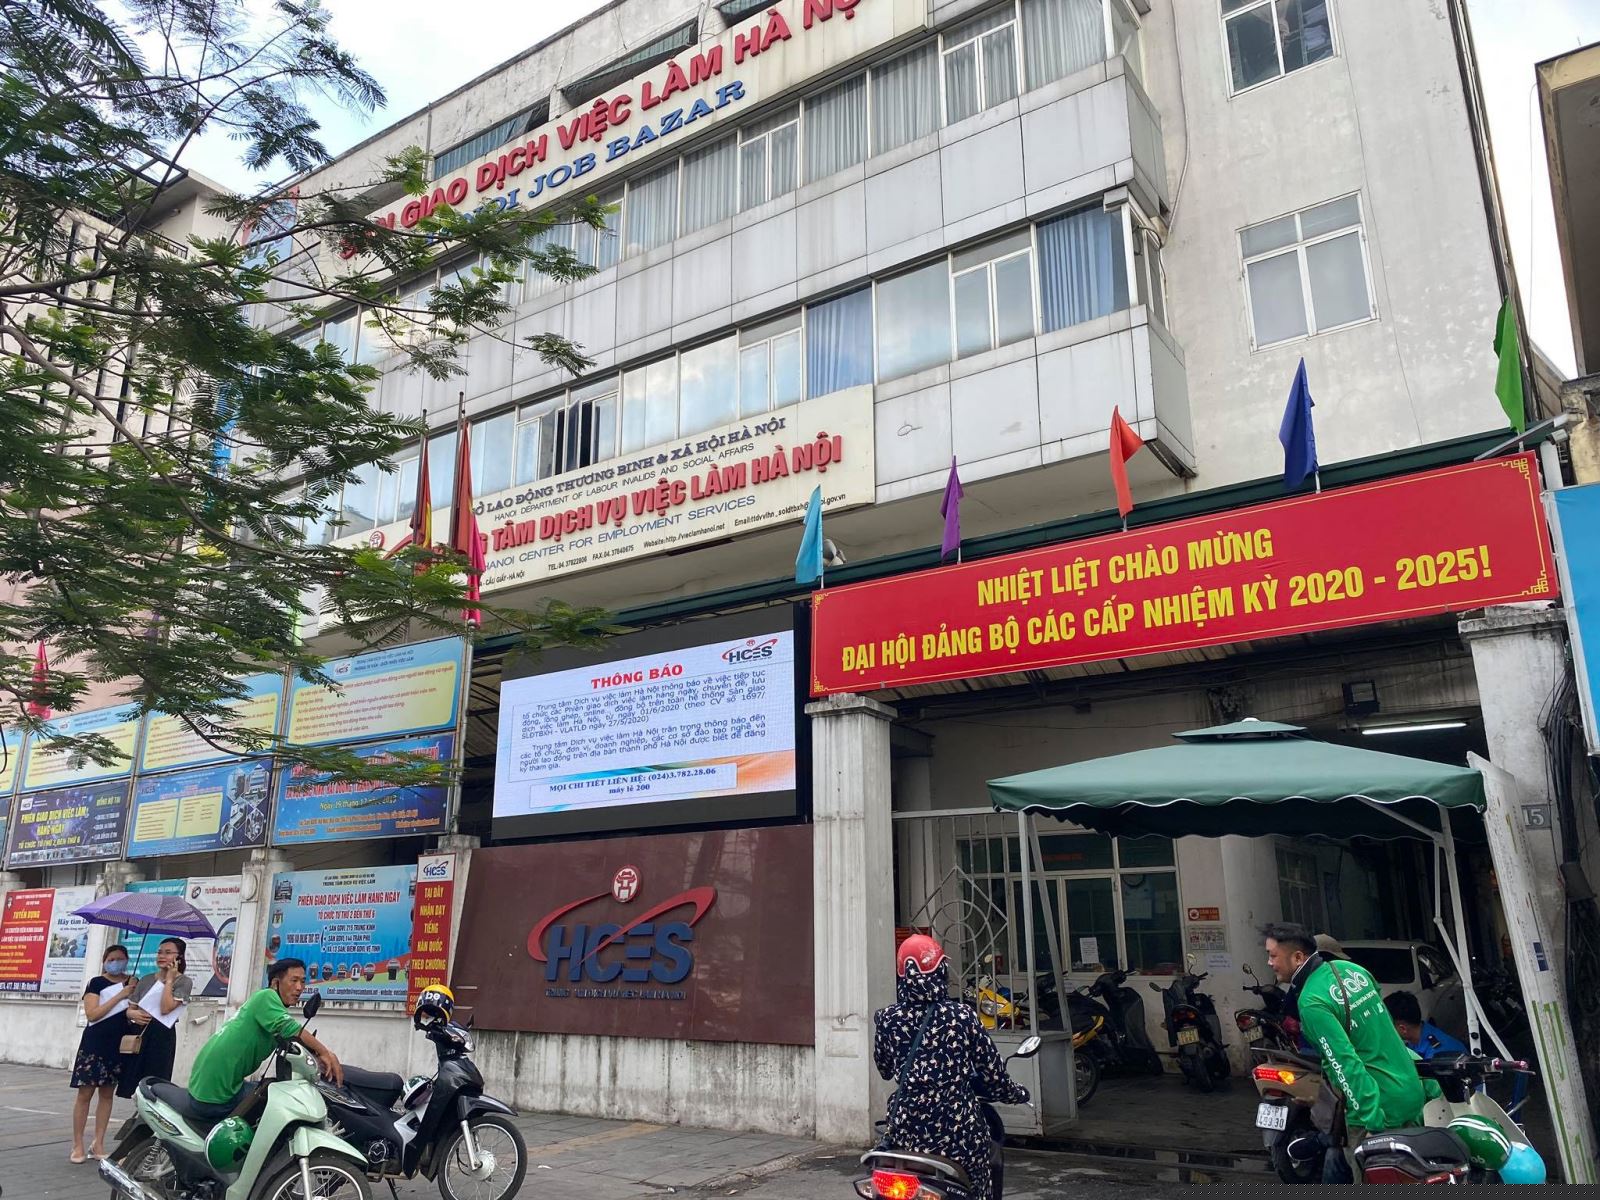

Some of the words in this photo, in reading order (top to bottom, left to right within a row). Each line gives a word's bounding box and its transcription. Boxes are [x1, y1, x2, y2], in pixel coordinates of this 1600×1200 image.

[400, 178, 469, 229] GIAO
[475, 133, 548, 190] DỊCH
[556, 94, 633, 150] VIỆC
[641, 44, 724, 111] LÀM
[734, 8, 793, 65] HÀ
[527, 151, 597, 199] JOB
[605, 80, 746, 162] BAZAR
[487, 497, 514, 513] LAO
[515, 485, 554, 505] ĐỘNG
[555, 467, 616, 493] THƯƠNG
[616, 456, 655, 477] BINH
[655, 453, 669, 465] &
[671, 442, 694, 462] XÃ
[695, 434, 726, 453] HỘI
[727, 424, 753, 444] HÀ
[754, 416, 787, 436] NỘI
[491, 519, 537, 552] TÂM
[539, 504, 594, 541] DỊCH
[596, 494, 628, 527] VỤ
[631, 477, 688, 517] VIỆC
[690, 463, 747, 501] LÀM
[751, 444, 790, 485] HÀ
[792, 431, 843, 474] NỘI
[494, 510, 517, 522] HANOI
[520, 496, 569, 515] DEPARTMENT
[571, 491, 584, 499] OF
[586, 481, 619, 497] LABOUR
[621, 471, 657, 487] INVALIDS
[660, 464, 679, 476] AND
[682, 456, 714, 470] SOCIAL
[718, 442, 756, 460] AFFAIRS
[519, 543, 565, 562] CENTER
[568, 537, 593, 551] FOR
[597, 514, 683, 544] EMPLOYMENT
[687, 495, 756, 521] SERVICES
[977, 567, 1044, 606] NHIỆT
[1050, 556, 1102, 597] LIỆT
[1108, 544, 1180, 585] CHÀO
[1187, 527, 1274, 571] MỪNG
[842, 641, 876, 675] ĐẠI
[881, 633, 916, 670] HỘI
[922, 623, 983, 661] ĐẢNG
[988, 615, 1021, 654] BỘ
[1026, 609, 1077, 646] CÁC
[1083, 594, 1136, 637] CẤP
[1142, 586, 1235, 629] NHIỆM
[1242, 574, 1280, 614] KỲ
[1288, 566, 1366, 608] 2020
[1373, 575, 1388, 585] -
[1395, 545, 1494, 592] 2025!
[728, 645, 773, 662] HCES
[591, 672, 643, 690] THÔNG
[649, 663, 683, 680] BÁO
[538, 702, 556, 711] Trung
[574, 696, 589, 705] Dịch
[602, 692, 616, 700] việc
[634, 687, 644, 695] Hà
[646, 685, 660, 694] Nội
[662, 682, 684, 691] thông
[686, 679, 700, 687] báo
[703, 676, 714, 684] về
[716, 674, 731, 685] việc
[734, 671, 750, 682] tiếp
[752, 669, 766, 678] tục
[586, 702, 602, 710] giao
[604, 699, 618, 708] dịch
[622, 696, 636, 705] việc
[656, 690, 674, 700] hàng
[702, 689, 725, 700] thống
[728, 687, 744, 696] Sàn
[748, 684, 766, 694] giao
[640, 704, 680, 716] 01/6/2020
[684, 700, 706, 711] (theo
[710, 698, 722, 706] CV
[742, 692, 766, 701] 1697/
[532, 743, 552, 752] Trung
[554, 740, 568, 748] tâm
[570, 738, 586, 746] Dịch
[600, 734, 614, 742] việc
[646, 728, 660, 736] Nội
[680, 723, 701, 734] trọng
[704, 720, 728, 730] thông
[731, 716, 746, 725] báo
[750, 714, 766, 722] đến
[608, 716, 650, 727] 27/5/2020)
[554, 754, 571, 764] động
[590, 750, 600, 758] địa
[604, 748, 617, 756] bàn
[620, 744, 640, 753] thành
[644, 742, 658, 752] phố
[674, 738, 687, 746] Nội
[690, 736, 710, 746] được
[712, 734, 728, 742] biết
[730, 730, 742, 740] để
[744, 729, 766, 739] đăng
[594, 741, 617, 750] doanh
[652, 735, 665, 743] các
[730, 722, 752, 732] nghề
[530, 763, 546, 771] tham
[550, 784, 566, 792] MỌI
[568, 782, 584, 790] CHI
[586, 779, 605, 788] TIẾT
[608, 777, 628, 786] LIÊN
[630, 775, 646, 784] HỆ:
[648, 768, 716, 782] (024)3.782.28.06
[1522, 808, 1544, 826] 15
[426, 864, 446, 876] HCES
[314, 894, 326, 906] GIAO
[341, 892, 354, 906] VIỆC
[424, 887, 433, 900] TẠI
[433, 885, 444, 898] ĐÂY
[420, 903, 435, 917] NHẬN
[436, 904, 446, 918] DẠY
[424, 920, 439, 934] TIẾNG
[417, 940, 428, 952] HÀN
[429, 937, 443, 952] QUỐC
[544, 922, 694, 985] HCES
[412, 959, 425, 970] THEO
[425, 958, 446, 970] CHƯƠNG
[414, 976, 430, 988] TRÌNH
[1329, 968, 1369, 1005] Grab
[426, 991, 440, 1000] be
[1368, 1136, 1396, 1145] HONDA
